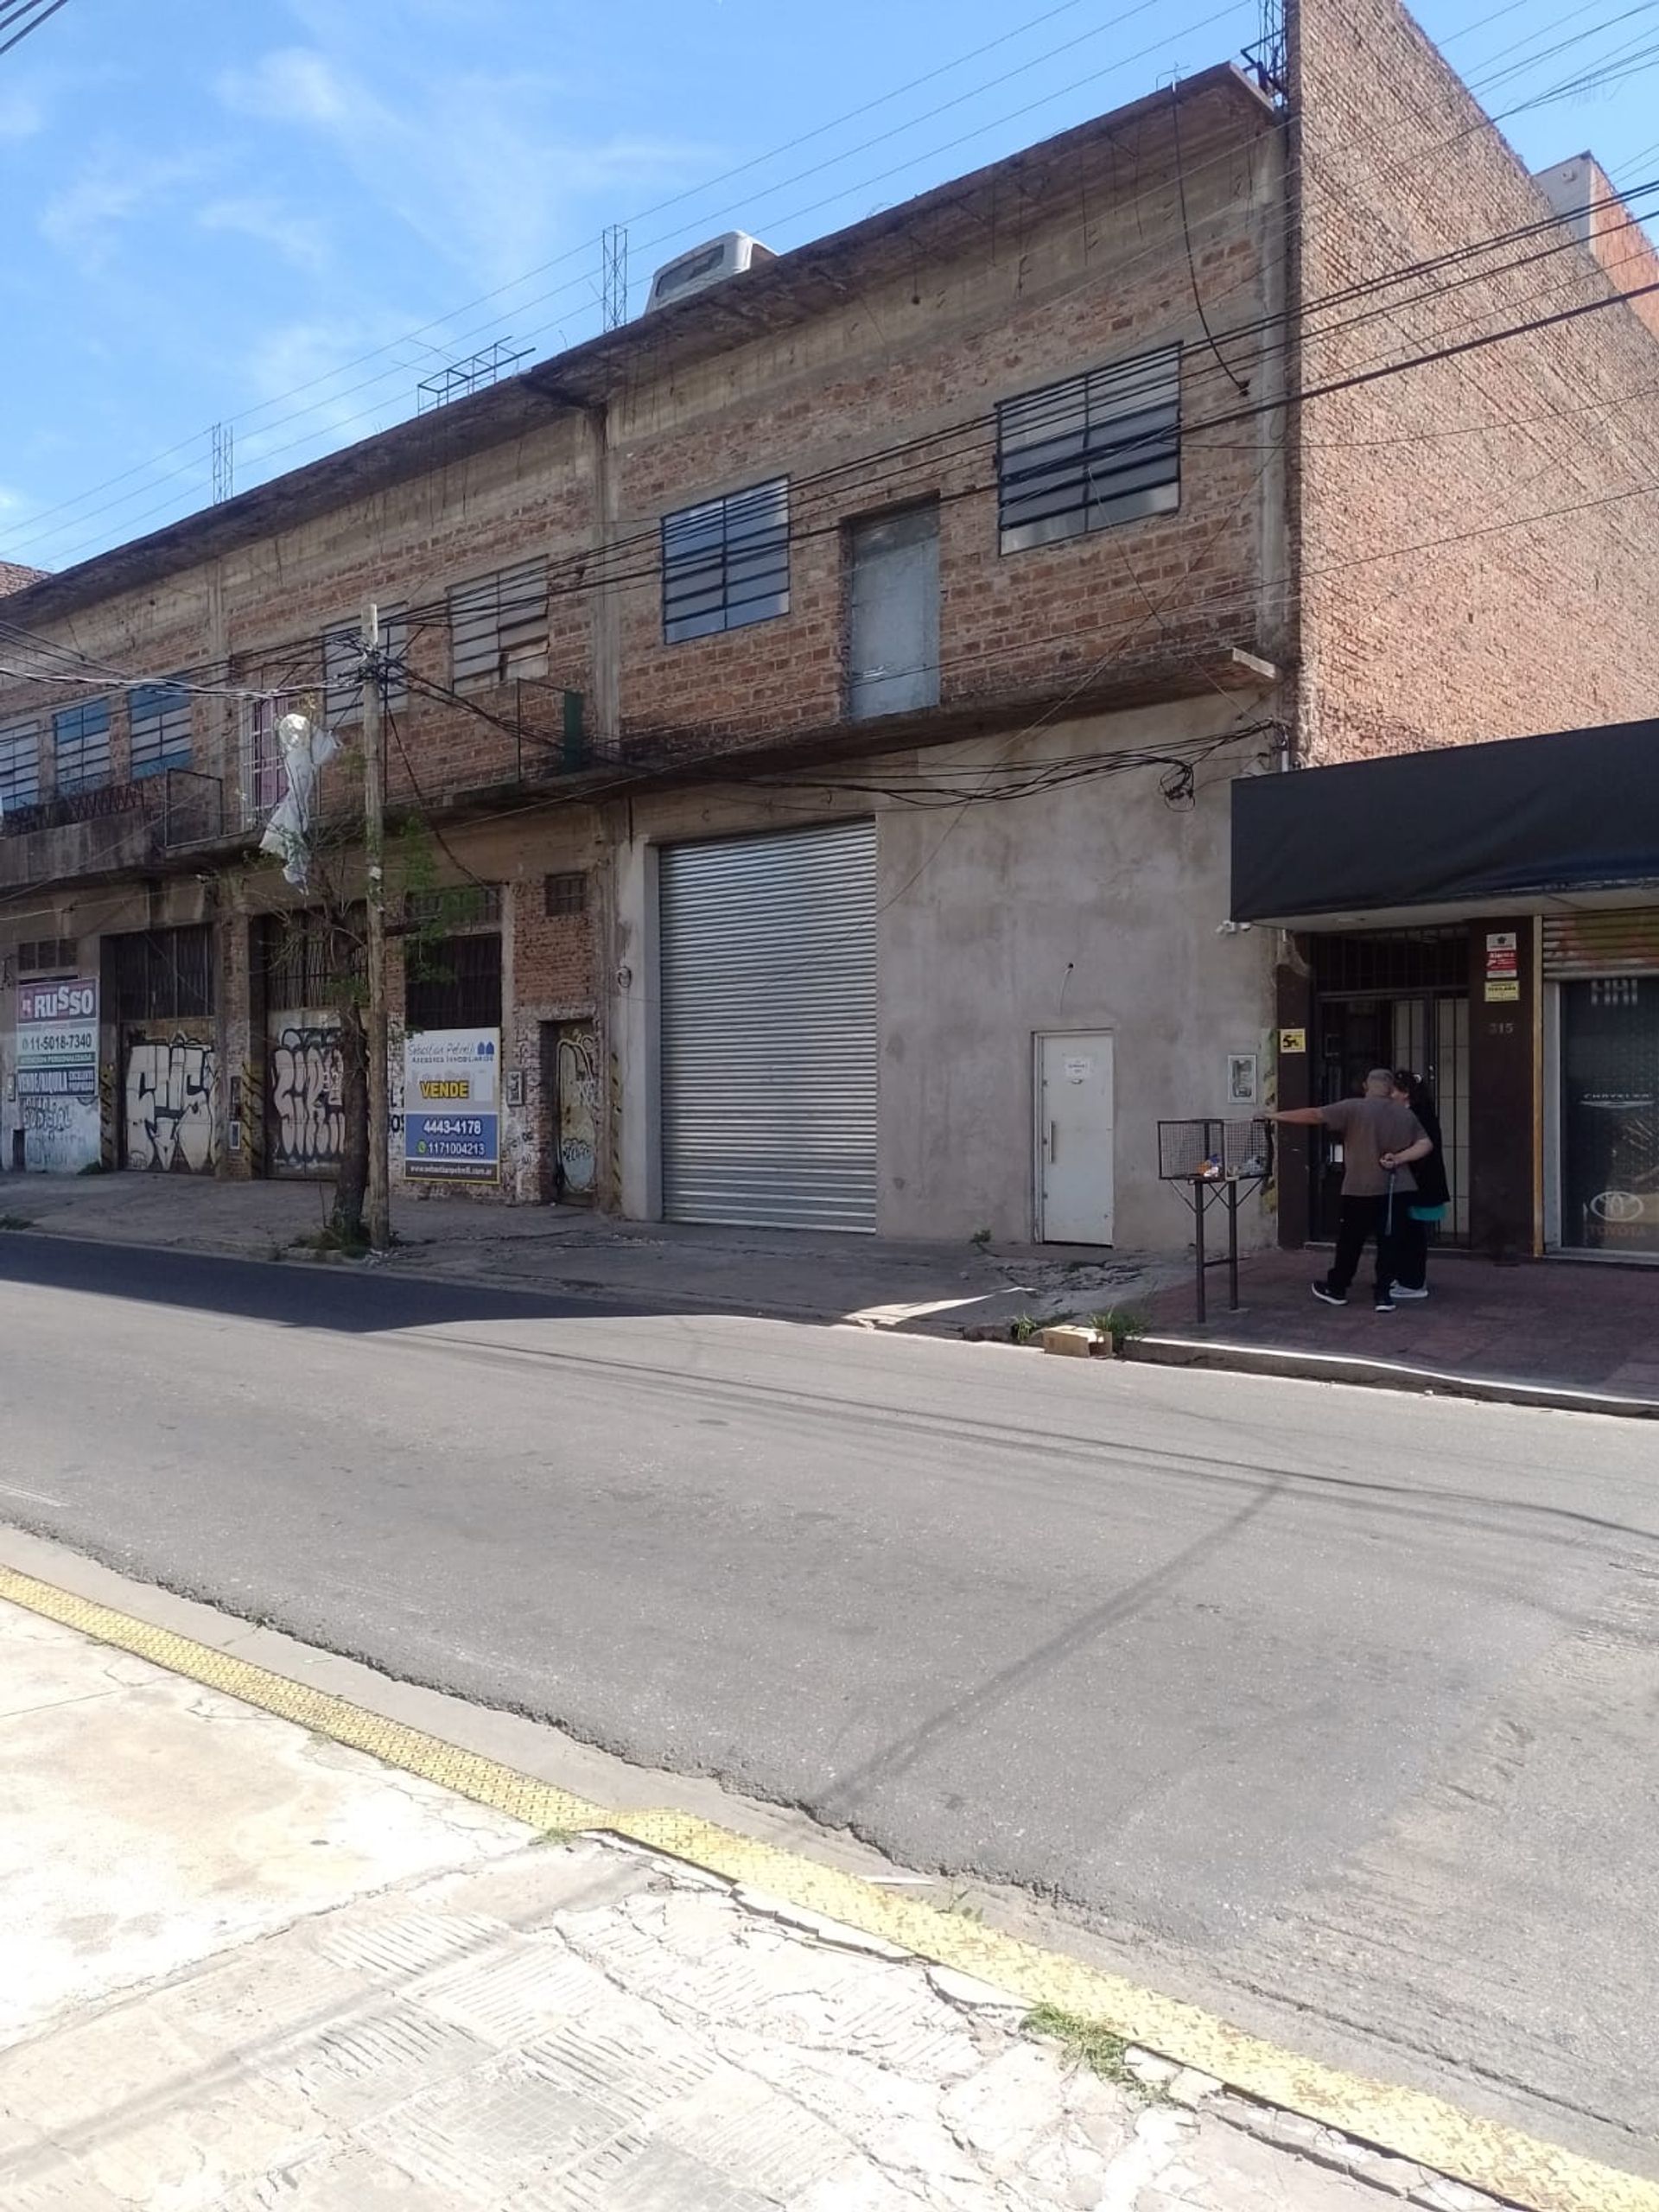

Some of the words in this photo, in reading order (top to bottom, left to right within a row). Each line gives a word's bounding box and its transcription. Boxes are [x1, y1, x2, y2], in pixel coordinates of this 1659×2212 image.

[34, 986, 94, 1018] RUSSO
[419, 1080, 469, 1099] VENDE
[423, 1119, 482, 1136] 4443-4178
[428, 1141, 486, 1156] 1171004213
